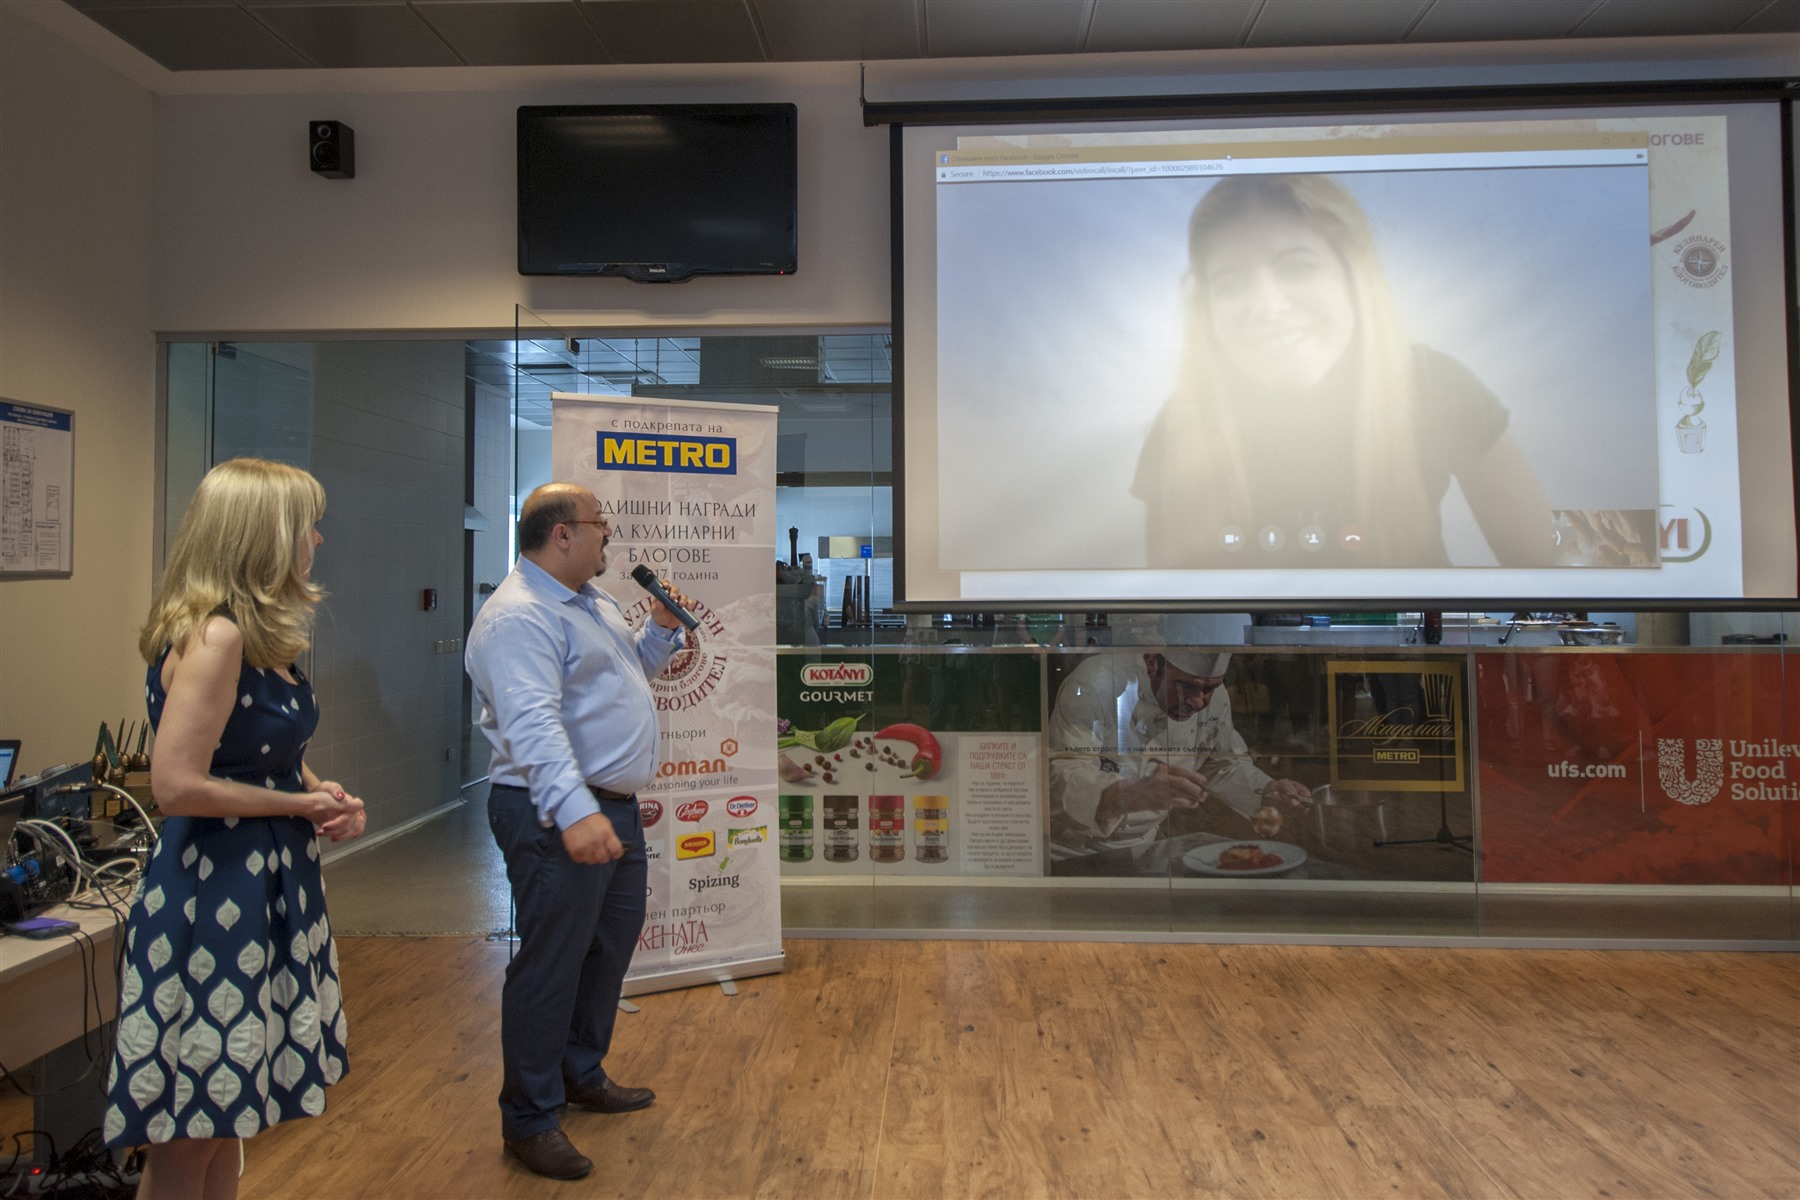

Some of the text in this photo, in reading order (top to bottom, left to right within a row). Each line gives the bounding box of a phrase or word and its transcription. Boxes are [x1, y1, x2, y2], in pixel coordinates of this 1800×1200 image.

[1650, 133, 1705, 146] ОГОВЕ
[950, 170, 974, 178] Secure
[624, 420, 703, 433] подкрепата
[708, 425, 723, 433] на
[603, 438, 731, 468] METRO
[597, 500, 757, 518] ДИШНИ НАГРАДИ
[631, 524, 736, 541] КУЛИНАРНИ
[628, 547, 712, 564] БЛОГОВЕ
[673, 571, 719, 581] година
[799, 691, 874, 704] GOURMET
[1376, 751, 1417, 761] METRO
[1547, 760, 1627, 778] ufs.com
[1729, 761, 1786, 779] Food
[646, 776, 739, 792] seasoning your life
[688, 874, 740, 892] Spizing
